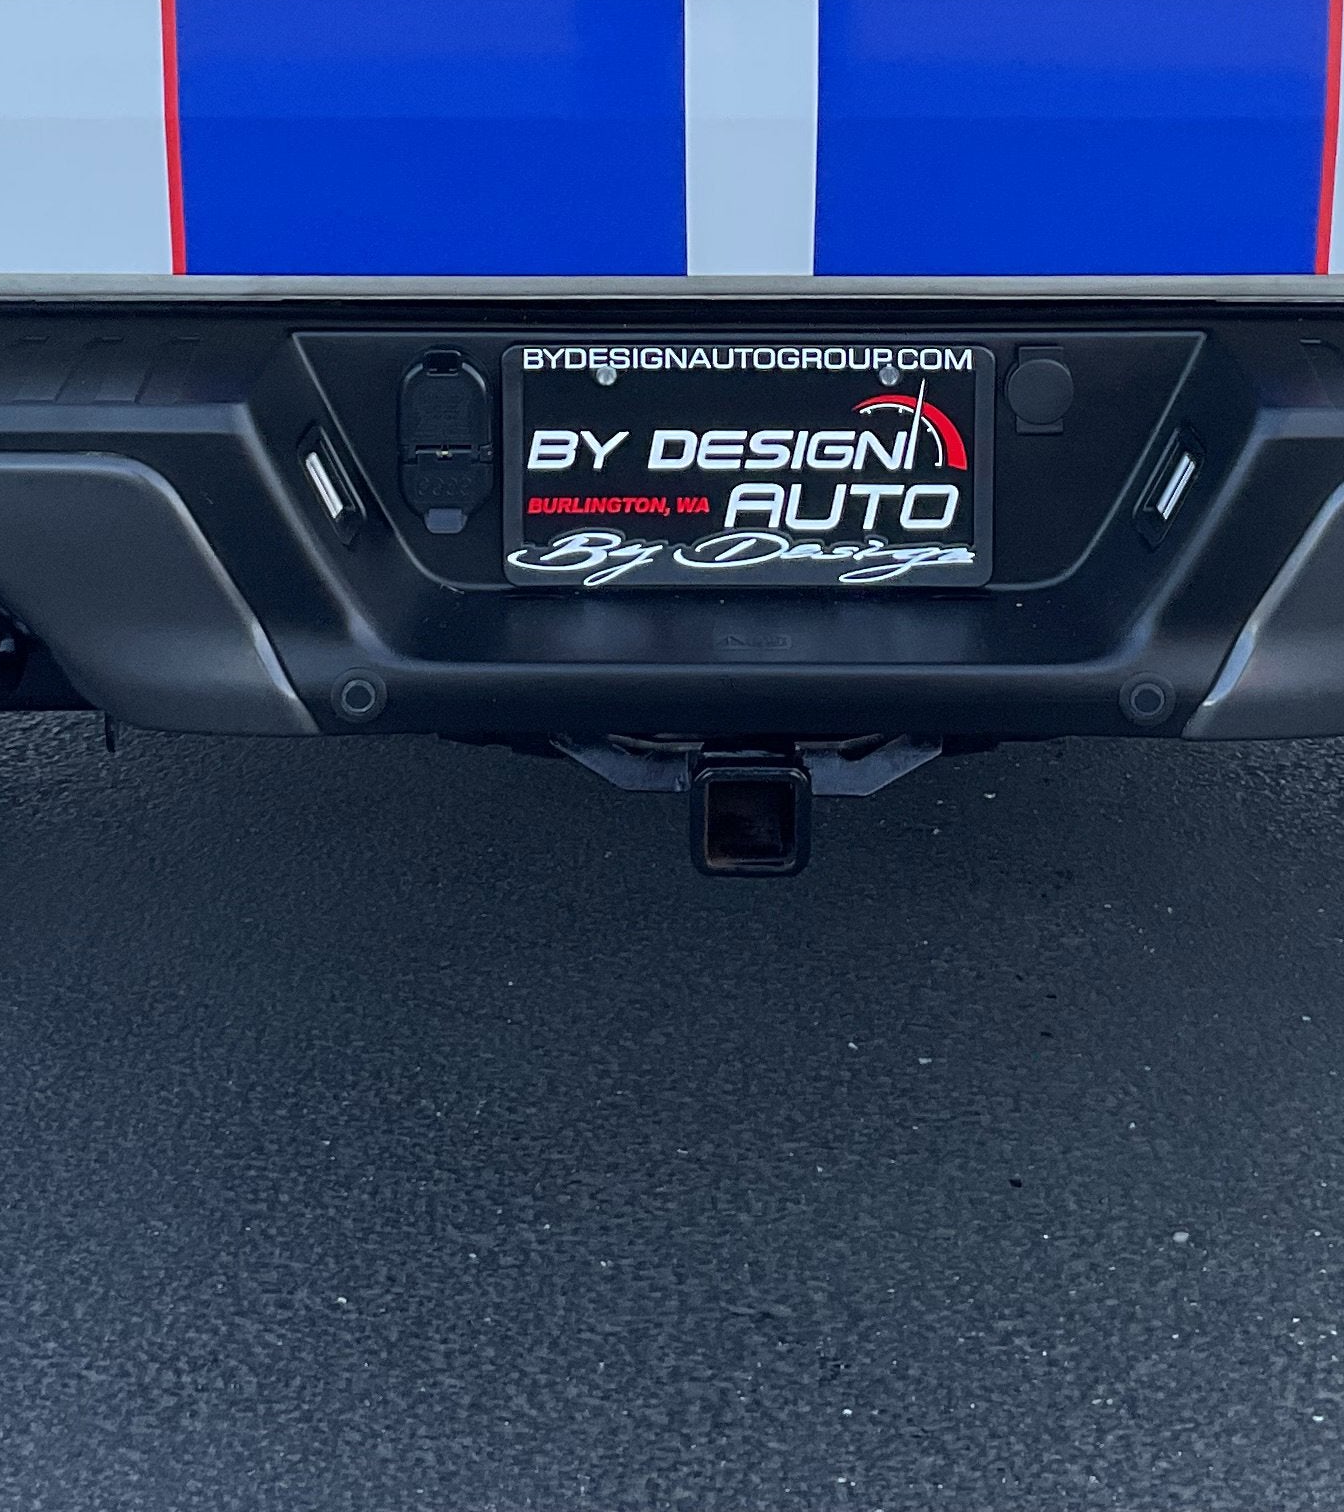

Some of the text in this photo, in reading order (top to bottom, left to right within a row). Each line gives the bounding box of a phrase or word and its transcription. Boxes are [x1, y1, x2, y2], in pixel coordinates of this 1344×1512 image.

[523, 348, 973, 370] BYDESIGNAUTOGROUP.COM
[527, 430, 909, 470] BY DESIGN
[528, 497, 710, 517] BURLINGTON, WA
[724, 483, 959, 530] AUTO
[507, 532, 976, 586] By Design
